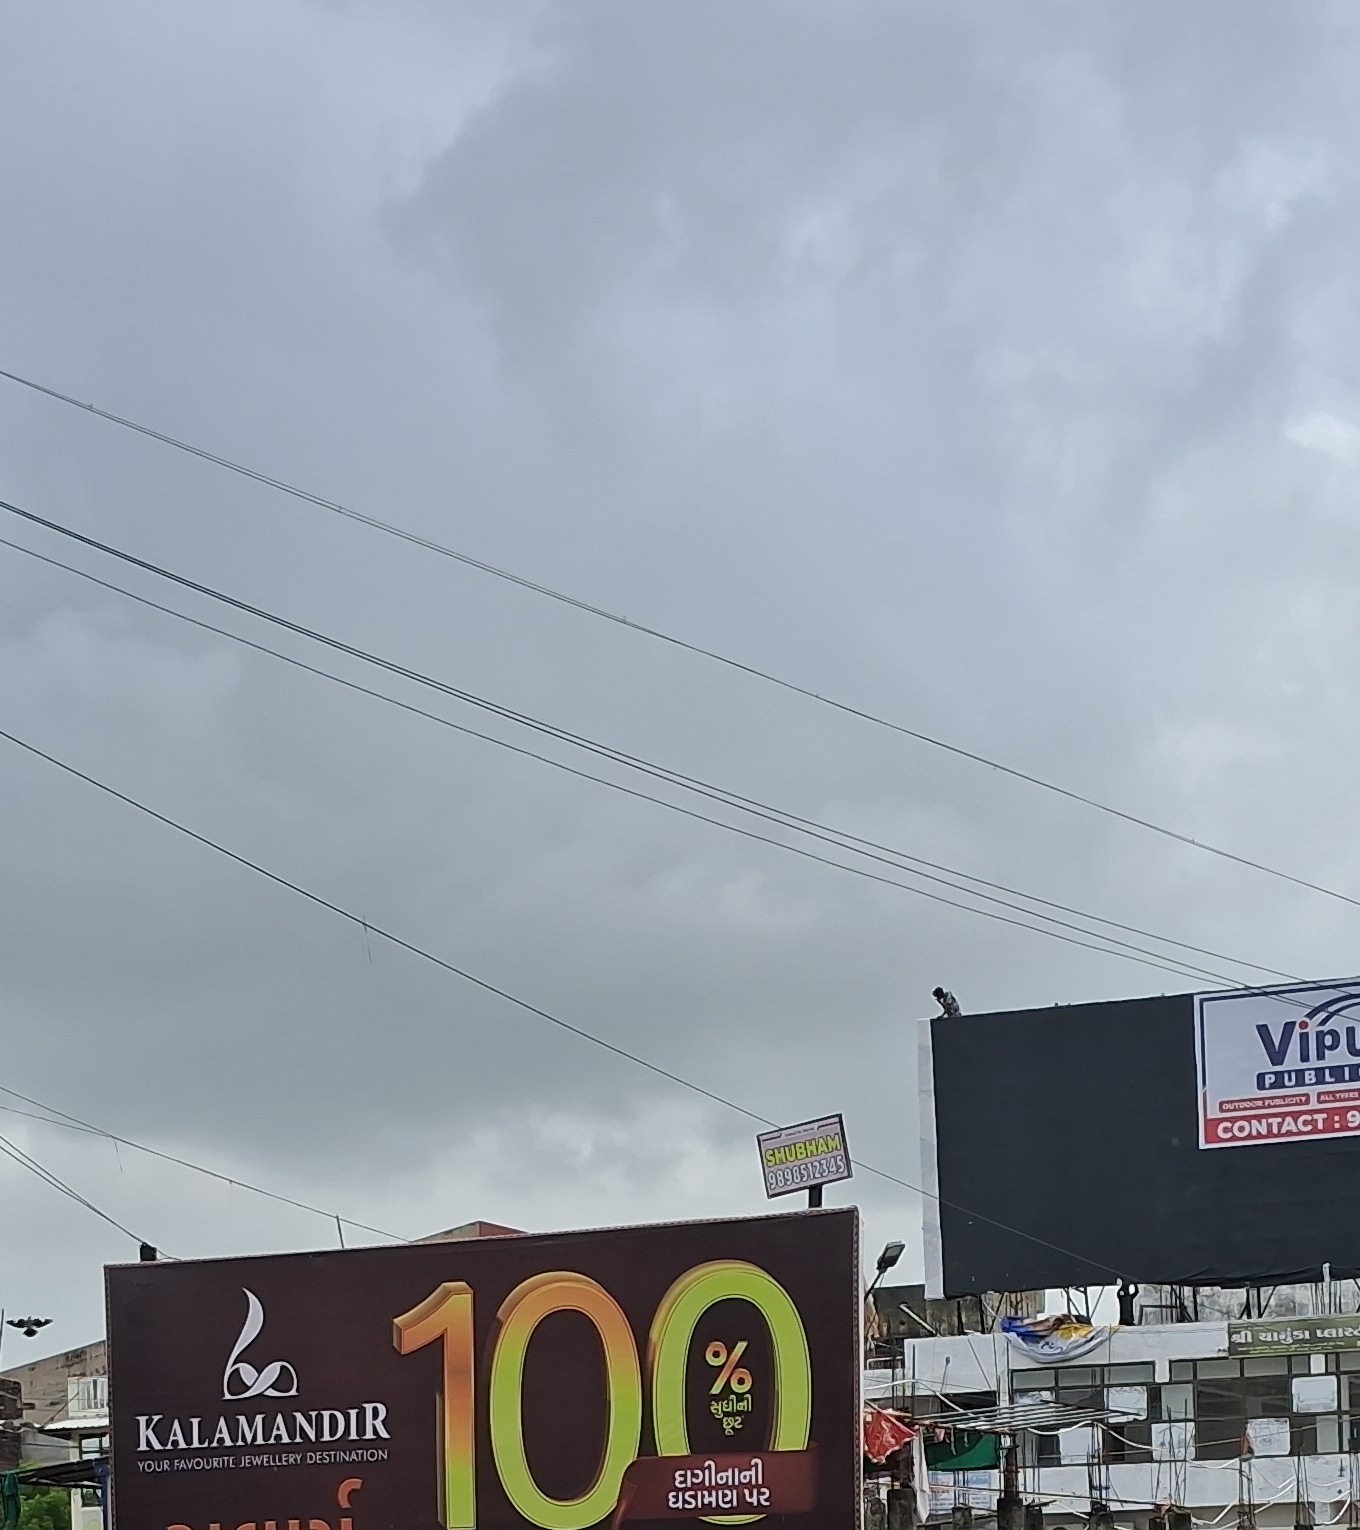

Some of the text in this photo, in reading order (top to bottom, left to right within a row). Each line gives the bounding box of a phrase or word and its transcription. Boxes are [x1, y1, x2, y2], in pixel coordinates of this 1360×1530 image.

[1320, 1093, 1334, 1101] ALL
[1217, 1114, 1327, 1139] CONTACT
[765, 1133, 841, 1168] SHUBHAM
[767, 1155, 845, 1190] 9898512345
[705, 1340, 753, 1395] %
[710, 1394, 752, 1419] સુધીની
[135, 1402, 391, 1451] KALAMANDIR
[138, 1449, 388, 1472] YOUR FAVOURITE JEWELLERY DESTINATION
[674, 1458, 764, 1488] દાગીનાની
[668, 1487, 771, 1510] ઘડામણ પર
